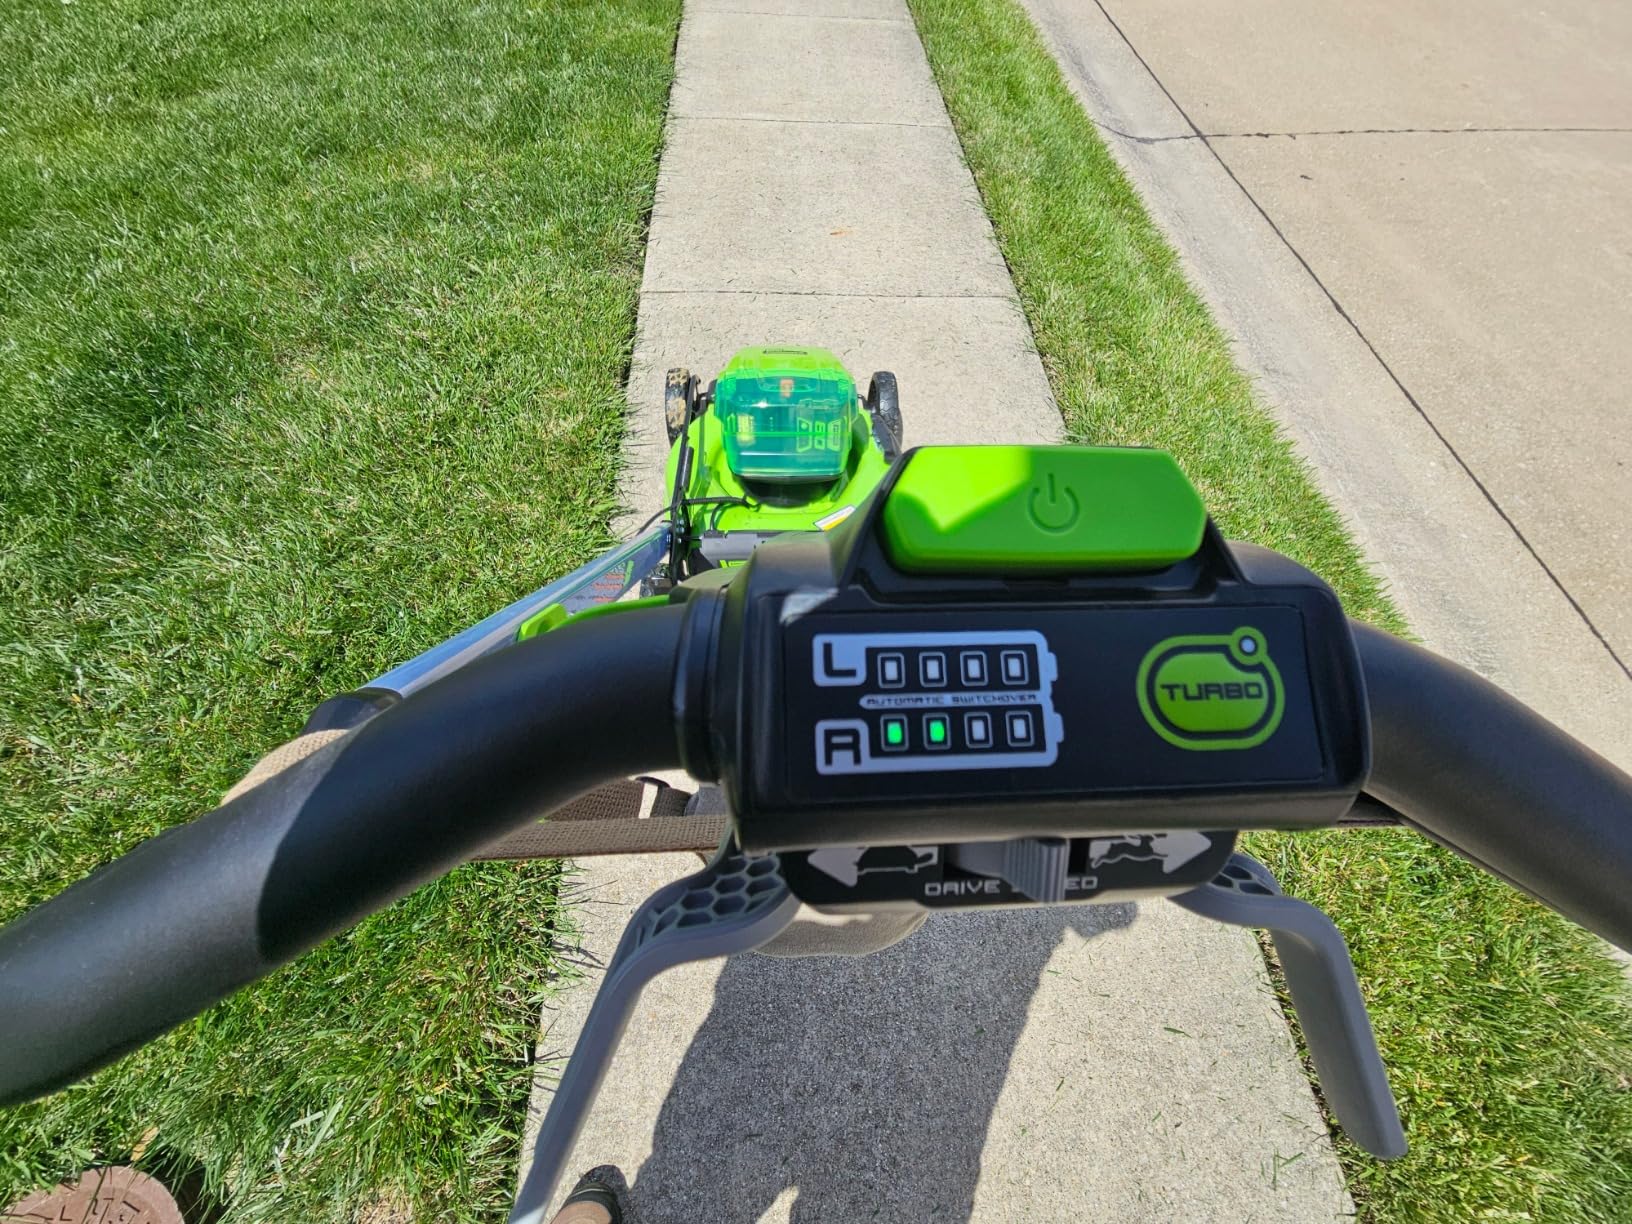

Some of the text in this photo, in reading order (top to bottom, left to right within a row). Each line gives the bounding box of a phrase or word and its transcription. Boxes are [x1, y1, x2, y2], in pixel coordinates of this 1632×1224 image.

[822, 642, 857, 678] L
[866, 693, 1037, 706] AUTOMATIC SWITCHOVER
[1160, 682, 1264, 701] TURBO
[924, 879, 1000, 896] DRIVE
